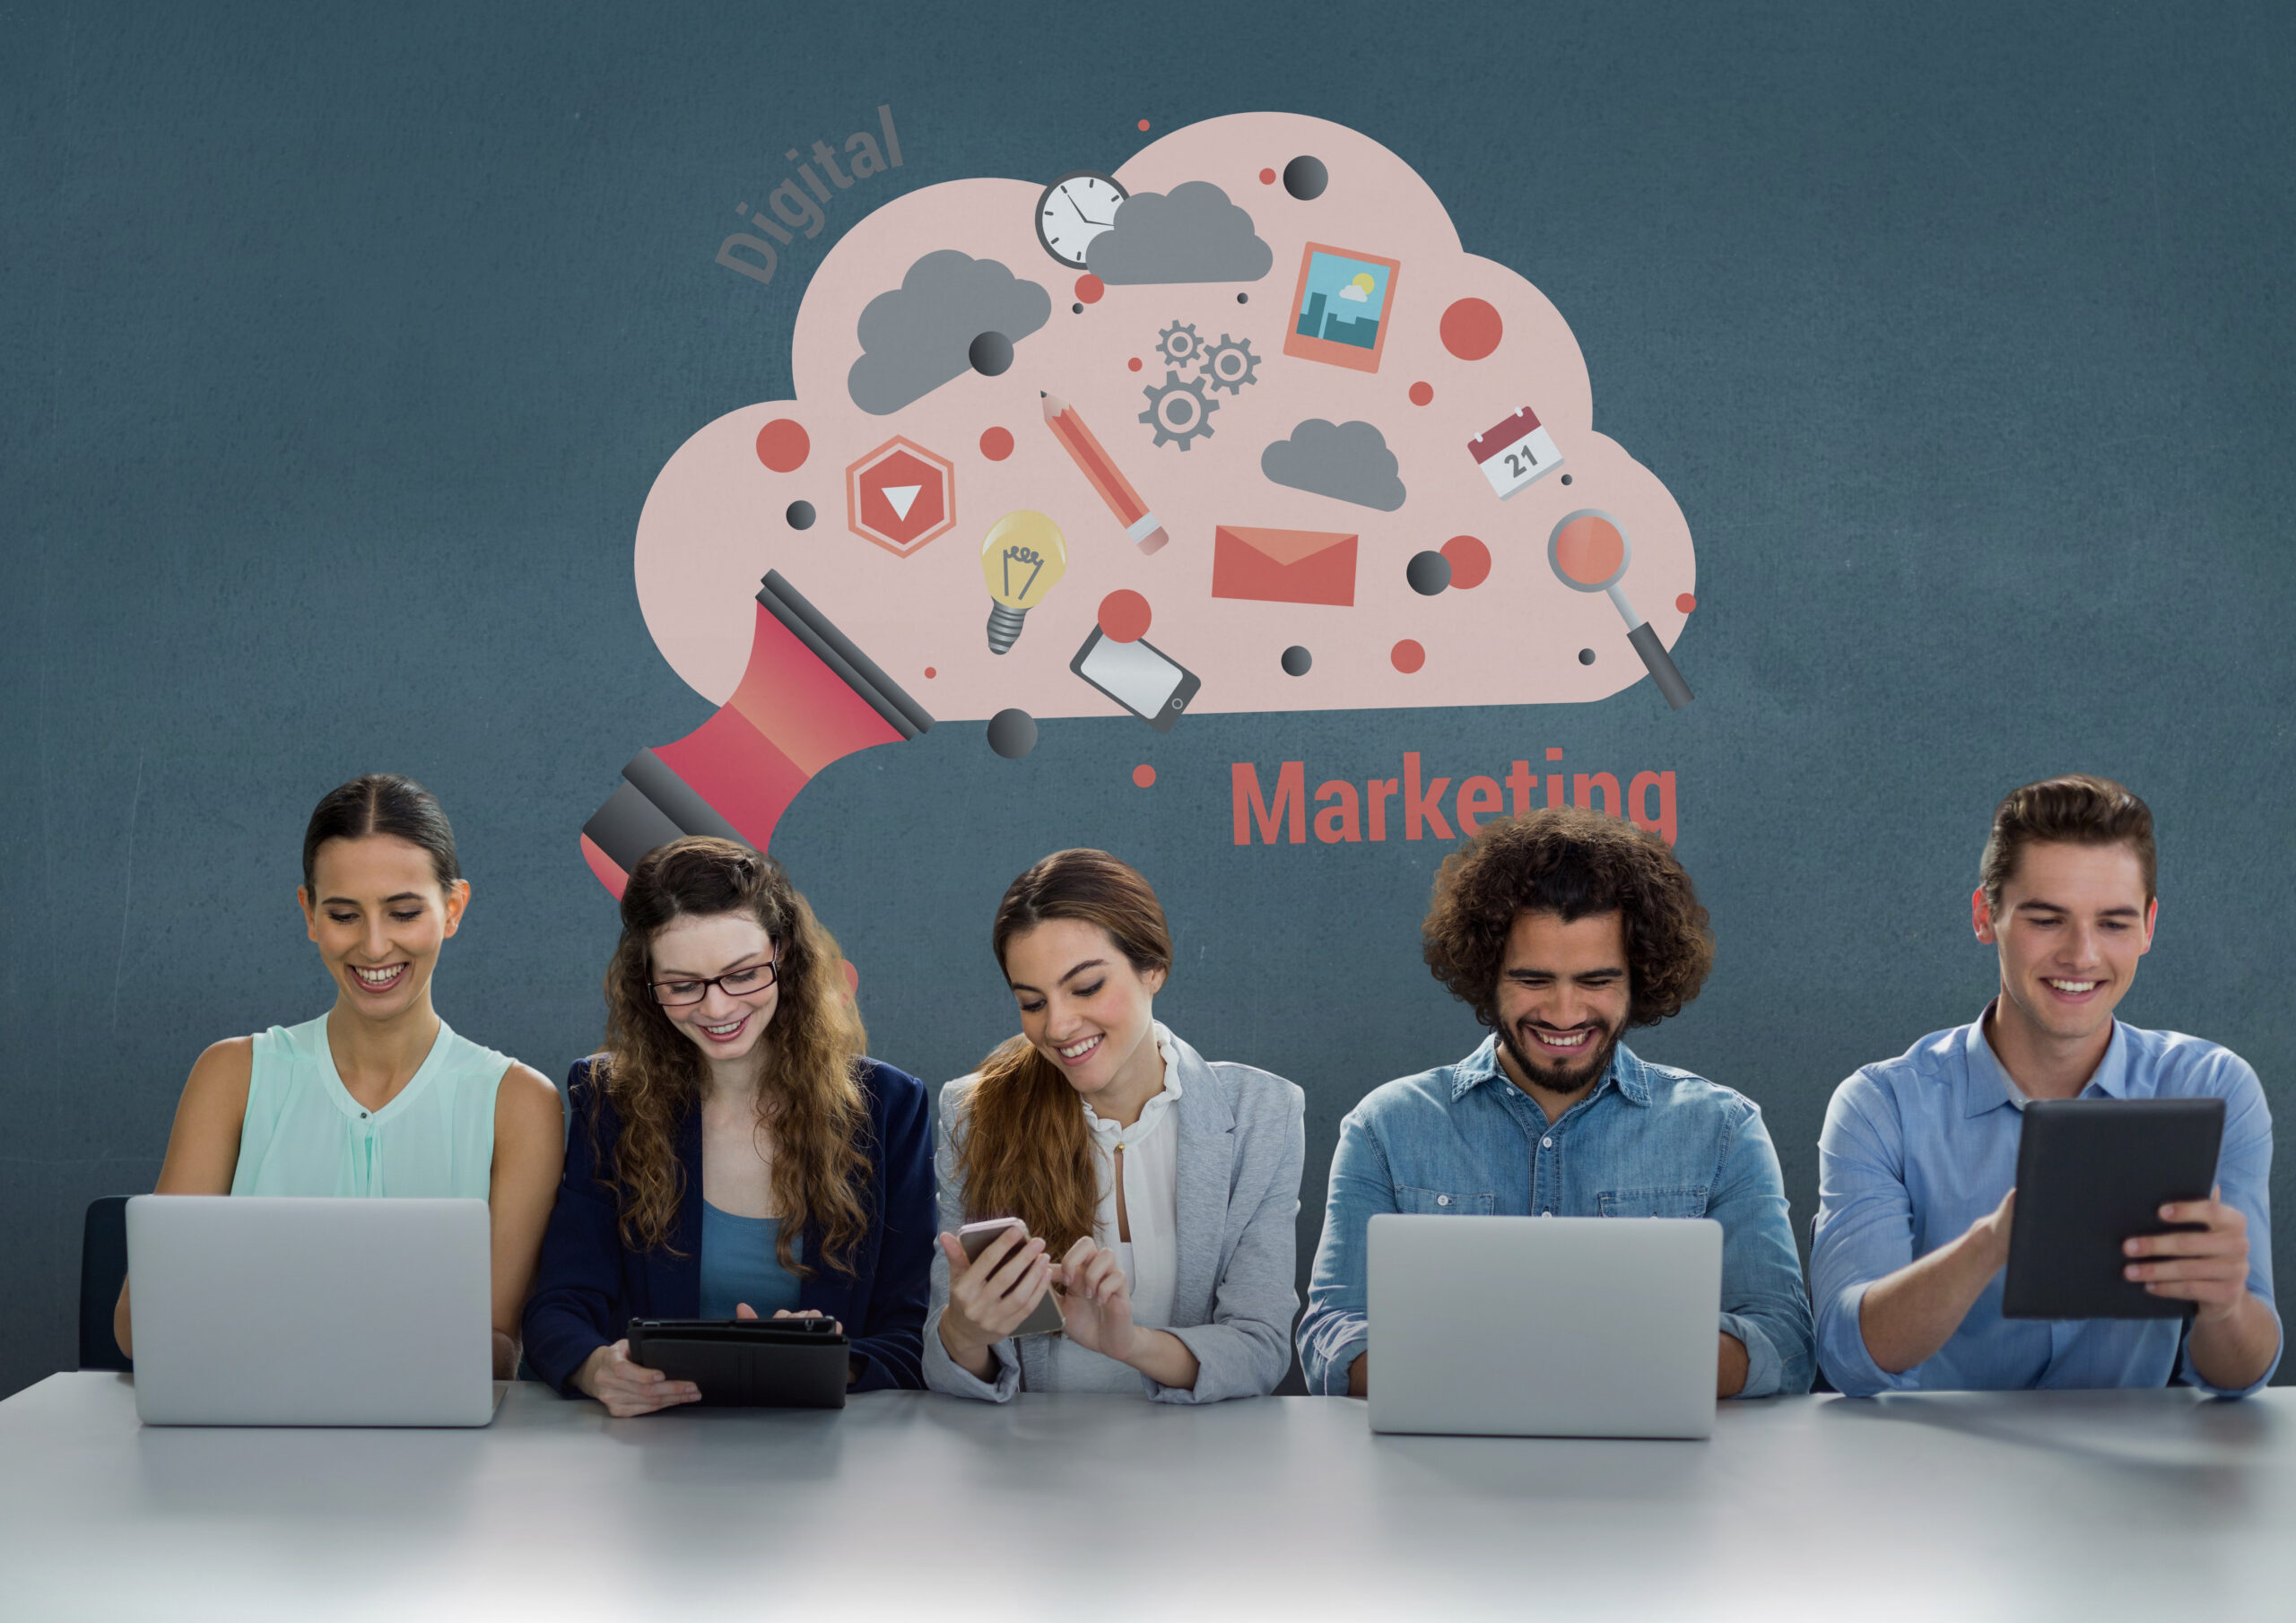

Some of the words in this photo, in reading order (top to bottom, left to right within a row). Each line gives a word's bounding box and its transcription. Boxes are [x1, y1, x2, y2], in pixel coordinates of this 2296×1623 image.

[715, 104, 904, 285] Digital
[1504, 445, 1538, 478] 21
[1231, 747, 1678, 849] Marketing
